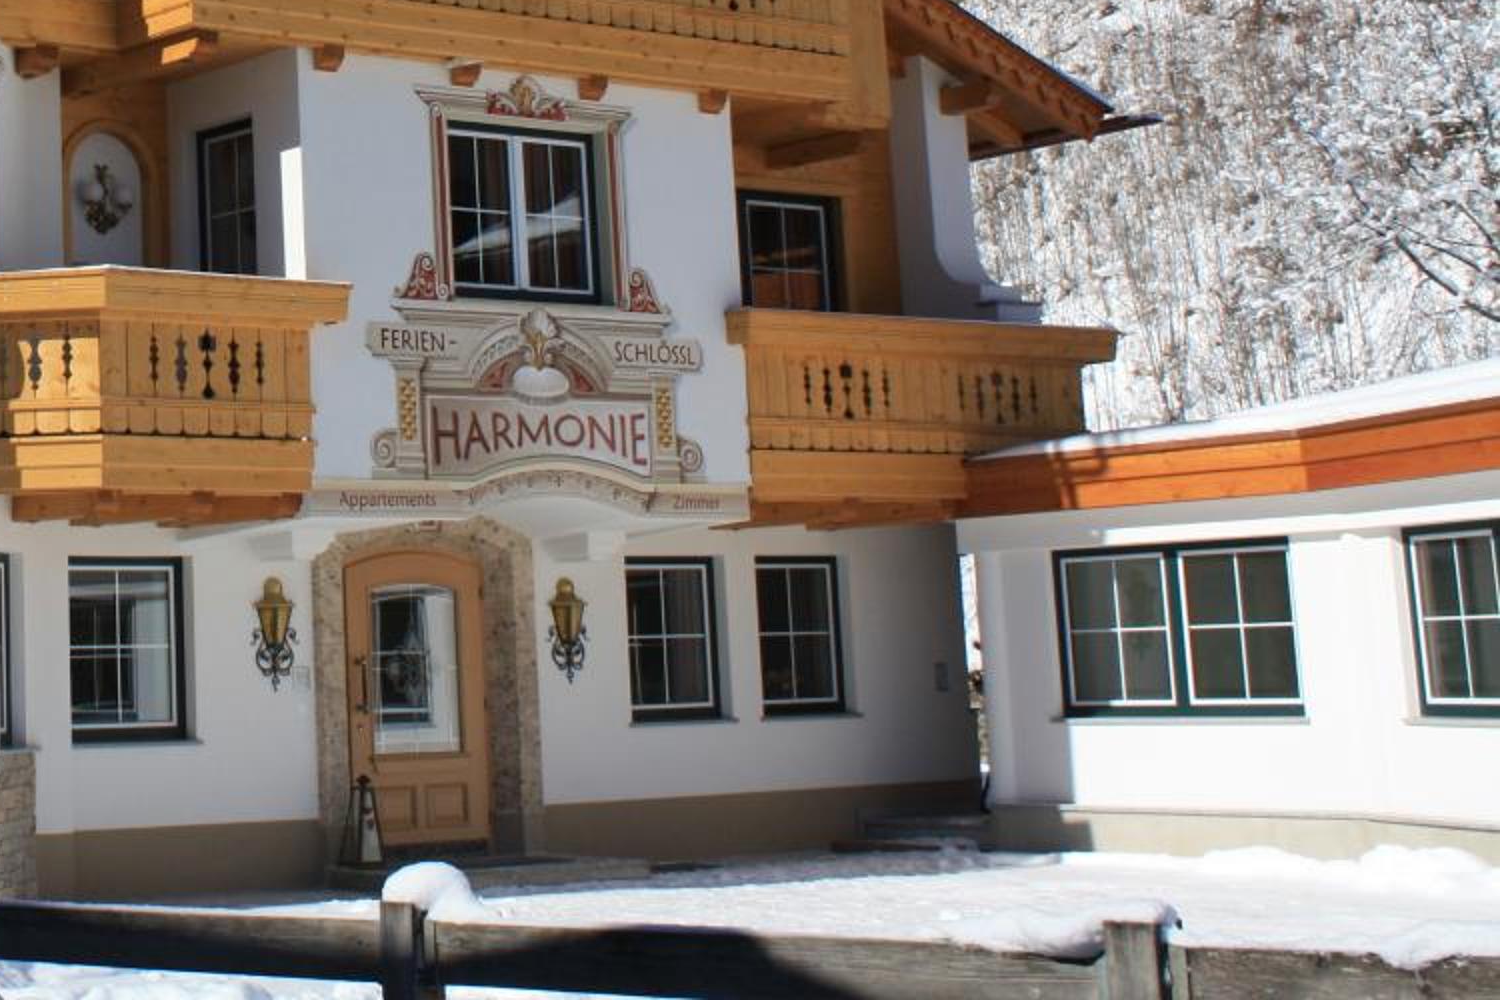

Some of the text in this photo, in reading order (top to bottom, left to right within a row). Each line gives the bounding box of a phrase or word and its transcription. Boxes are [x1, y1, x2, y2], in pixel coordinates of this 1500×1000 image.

[381, 327, 696, 366] FERIEN- SCHLÖSSL
[431, 405, 647, 466] HARMONIE
[339, 490, 437, 512] Appartements
[673, 494, 721, 510] Zimmer
